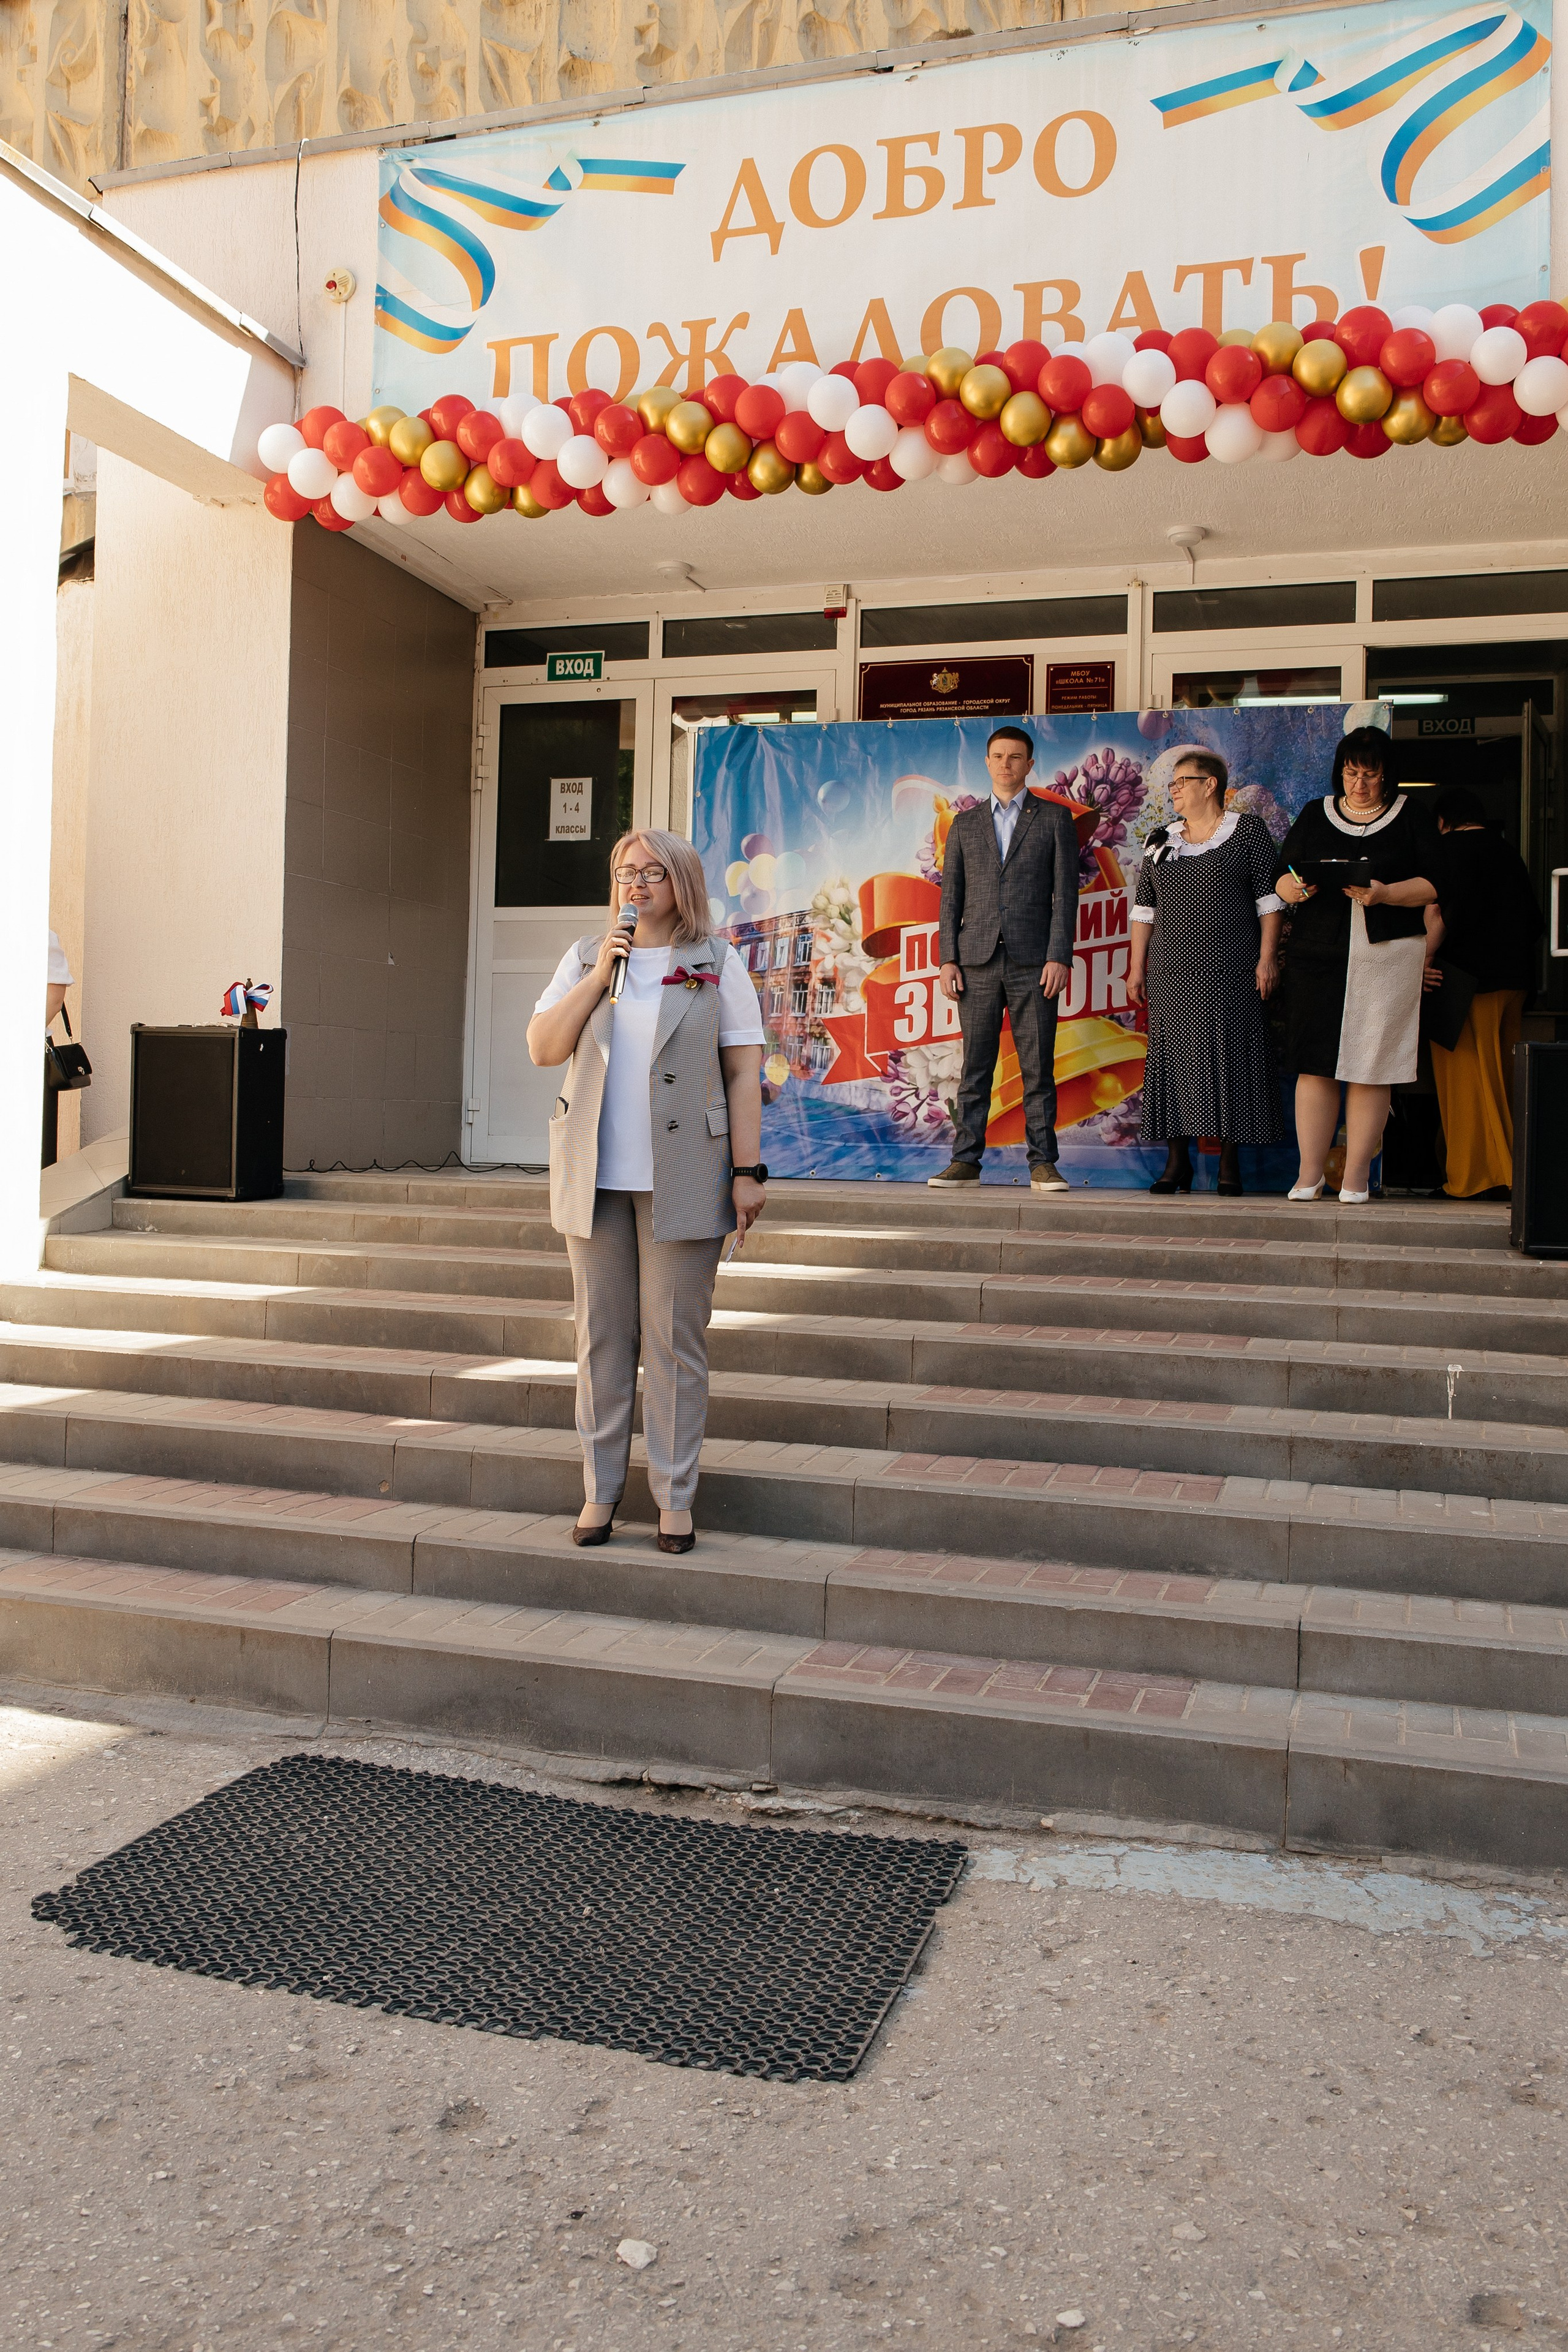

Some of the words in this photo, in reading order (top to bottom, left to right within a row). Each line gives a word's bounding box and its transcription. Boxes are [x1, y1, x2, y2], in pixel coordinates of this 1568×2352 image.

[710, 110, 1117, 263] ДОБРО
[556, 658, 594, 677] ВХОД
[1422, 718, 1471, 734] ВХОД
[560, 782, 583, 795] ВХОД
[556, 825, 586, 834] классы
